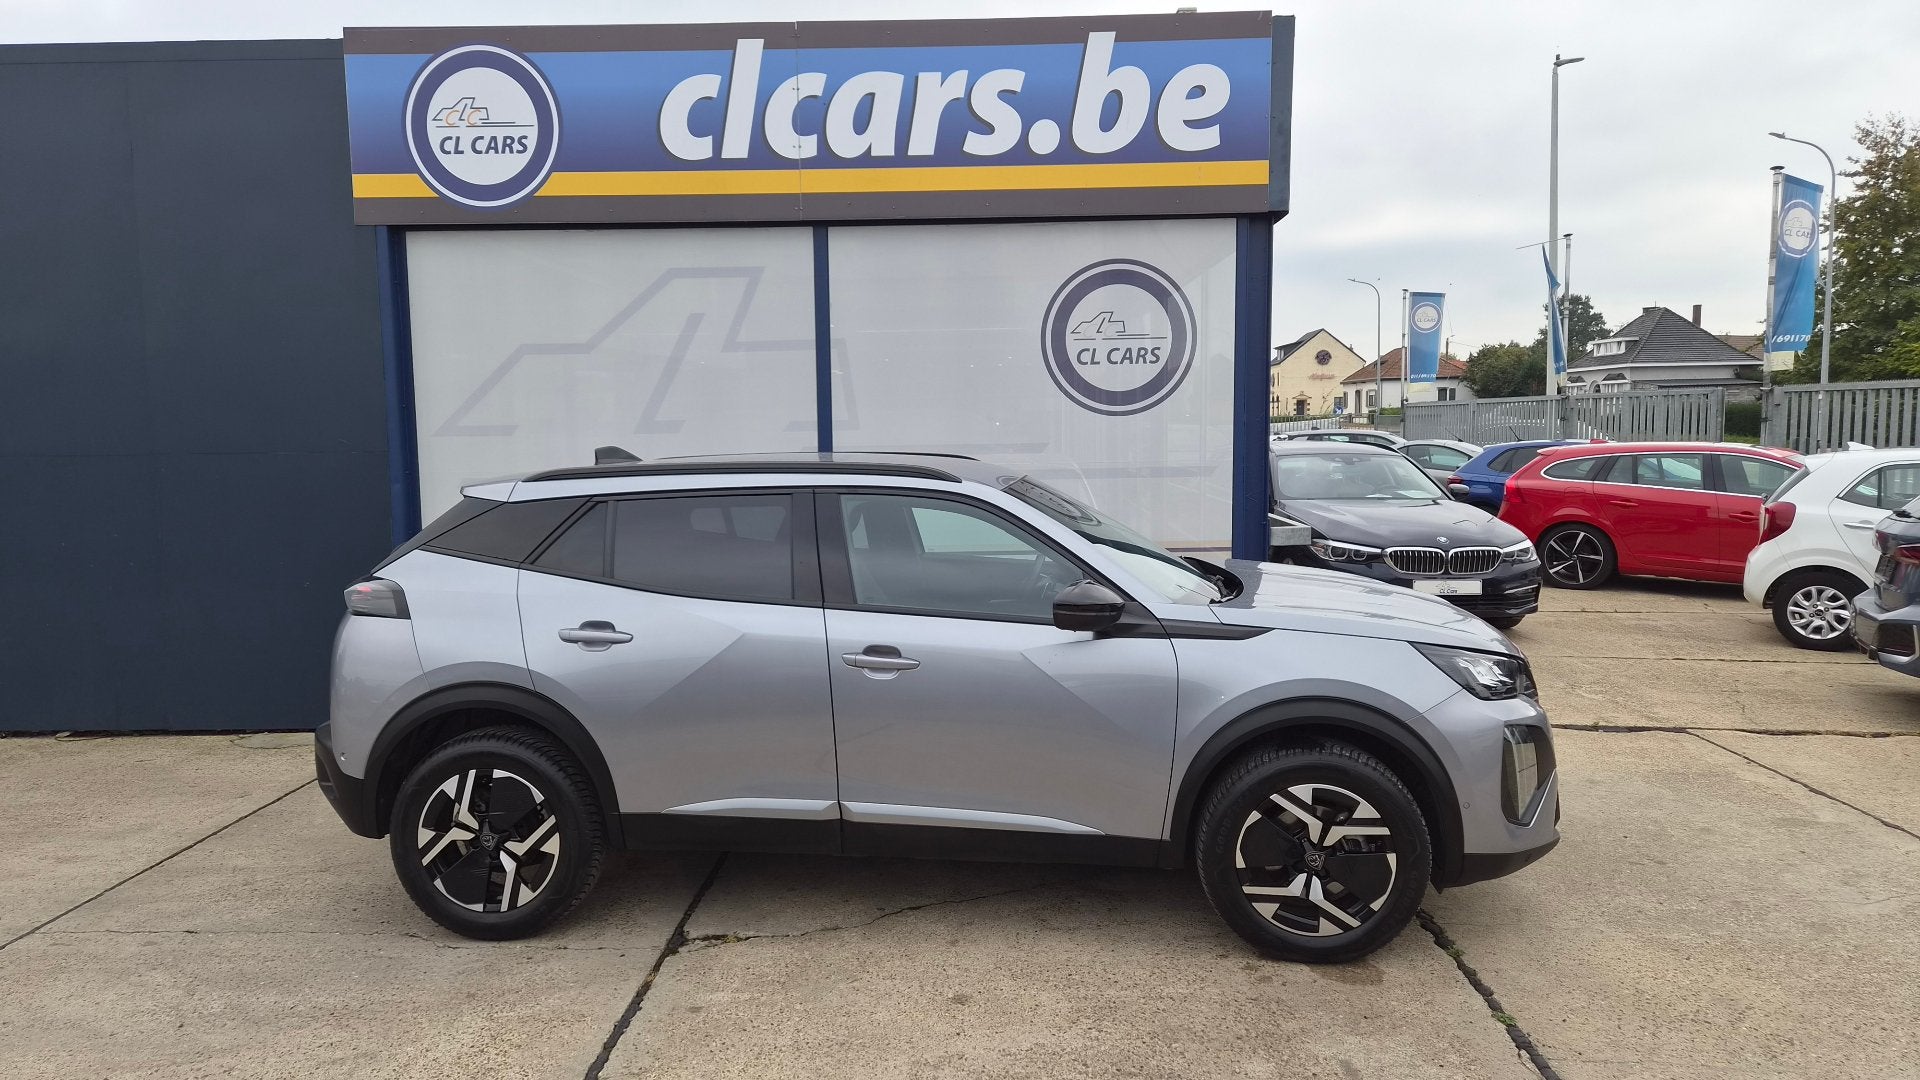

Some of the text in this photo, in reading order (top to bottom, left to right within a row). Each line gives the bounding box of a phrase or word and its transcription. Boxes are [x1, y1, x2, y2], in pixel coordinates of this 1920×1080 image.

[659, 31, 1231, 161] clcars.be
[439, 134, 529, 155] CL CARS
[1076, 346, 1161, 366] CL CARS
